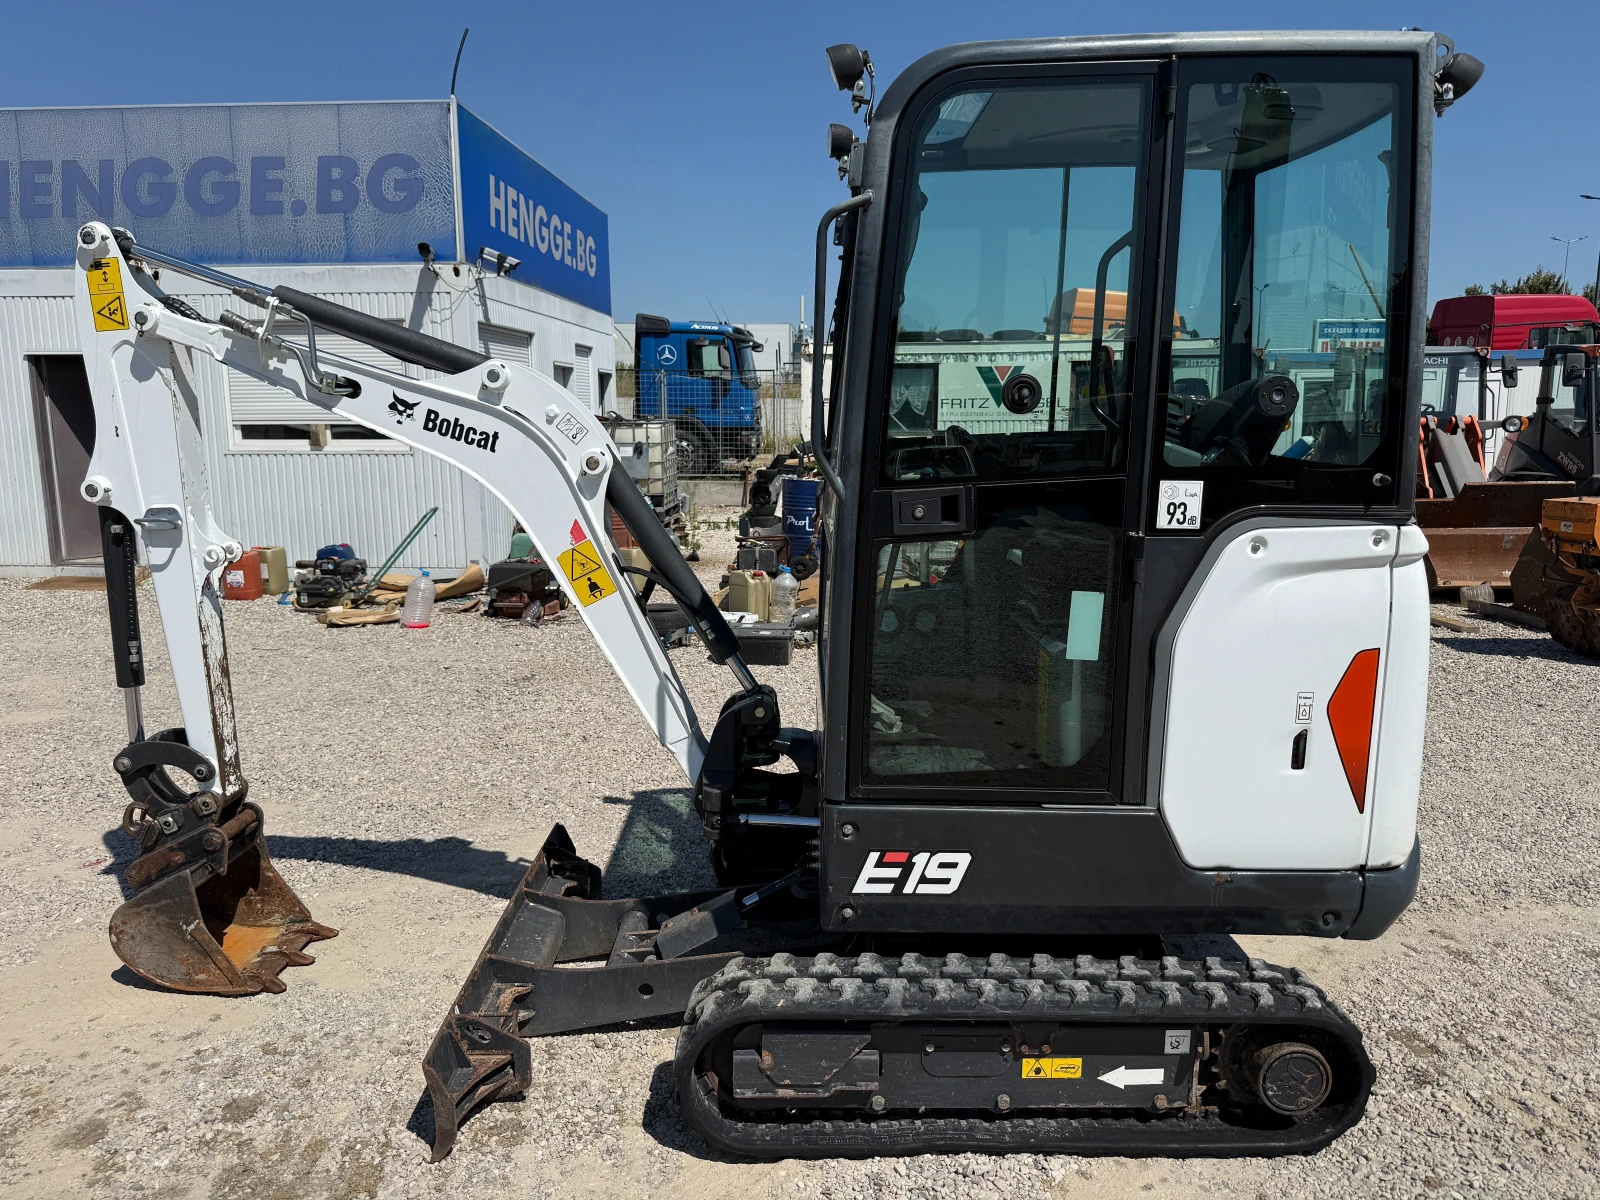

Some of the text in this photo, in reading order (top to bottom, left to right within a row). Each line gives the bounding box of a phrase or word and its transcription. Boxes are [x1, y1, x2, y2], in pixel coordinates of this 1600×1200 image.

[0, 155, 424, 218] ENGGE.BG
[489, 173, 597, 278] HENGGE.BG
[1423, 357, 1449, 365] ACHI
[940, 397, 990, 409] FRITZ
[422, 408, 500, 453] Bobcat
[1567, 451, 1585, 471] HITACHI
[1166, 501, 1198, 526] 93 dB
[852, 851, 972, 895] E19
